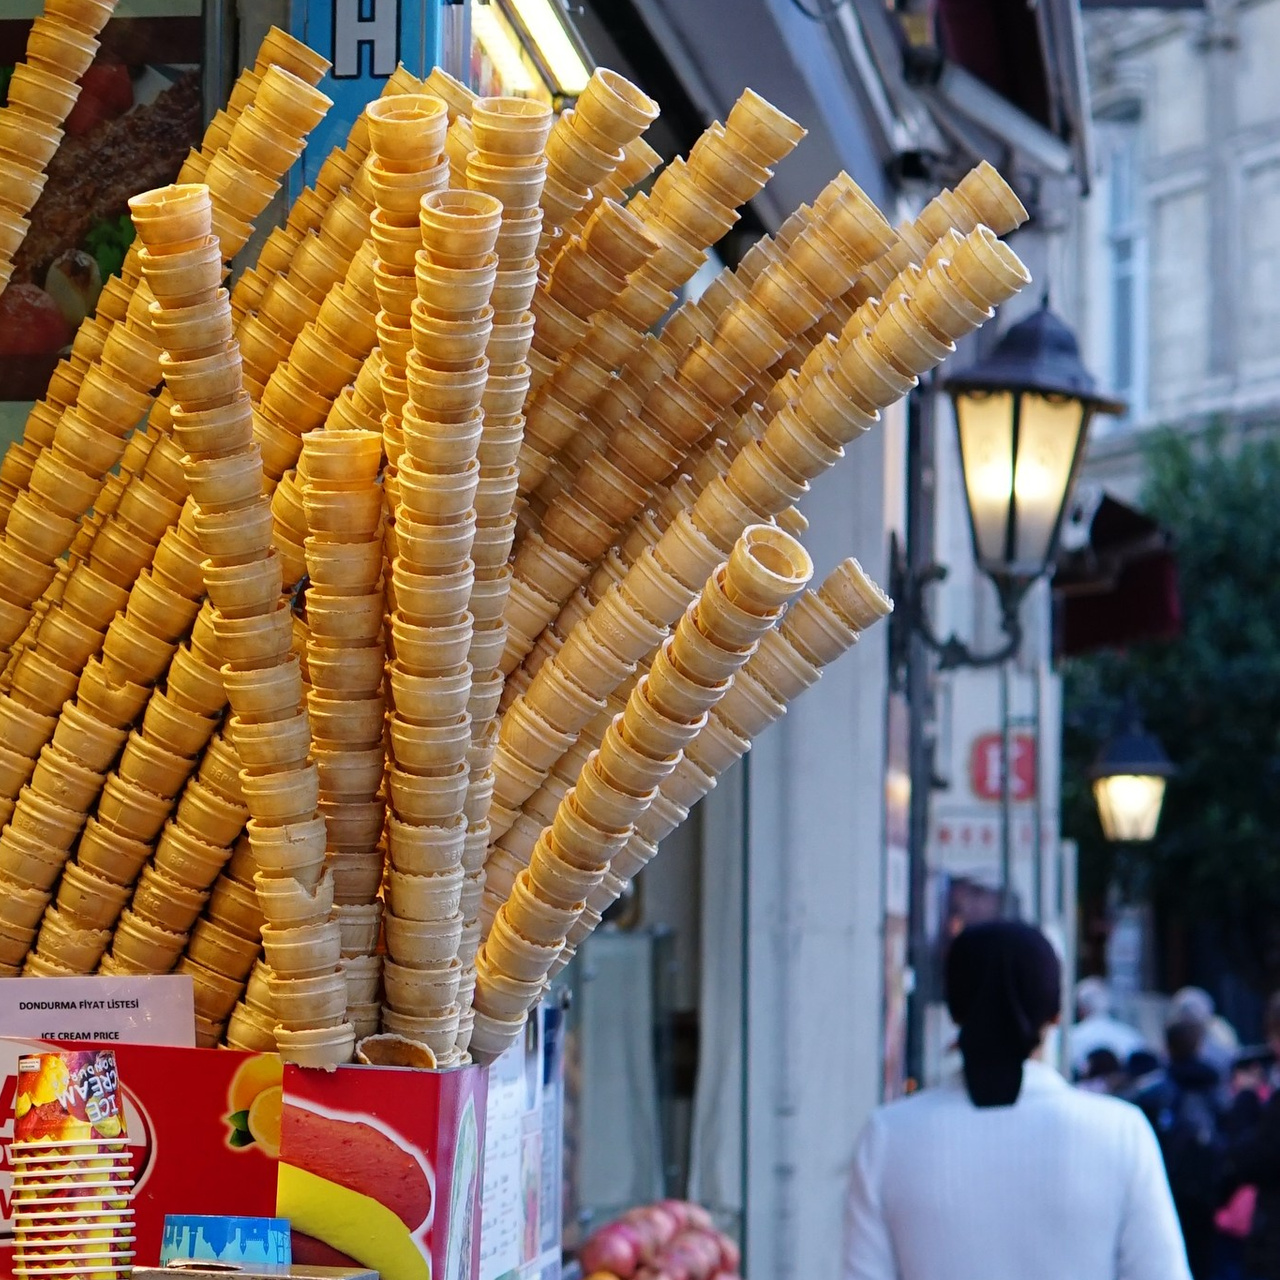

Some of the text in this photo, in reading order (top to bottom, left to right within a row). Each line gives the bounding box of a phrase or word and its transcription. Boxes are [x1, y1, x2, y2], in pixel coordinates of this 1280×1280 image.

[19, 998, 139, 1010] DONDURMA FİYAT LİSTESİ
[41, 1031, 119, 1040] ICE CREAM PRICE
[56, 1072, 119, 1110] CREAM
[86, 1095, 120, 1123] ICE
